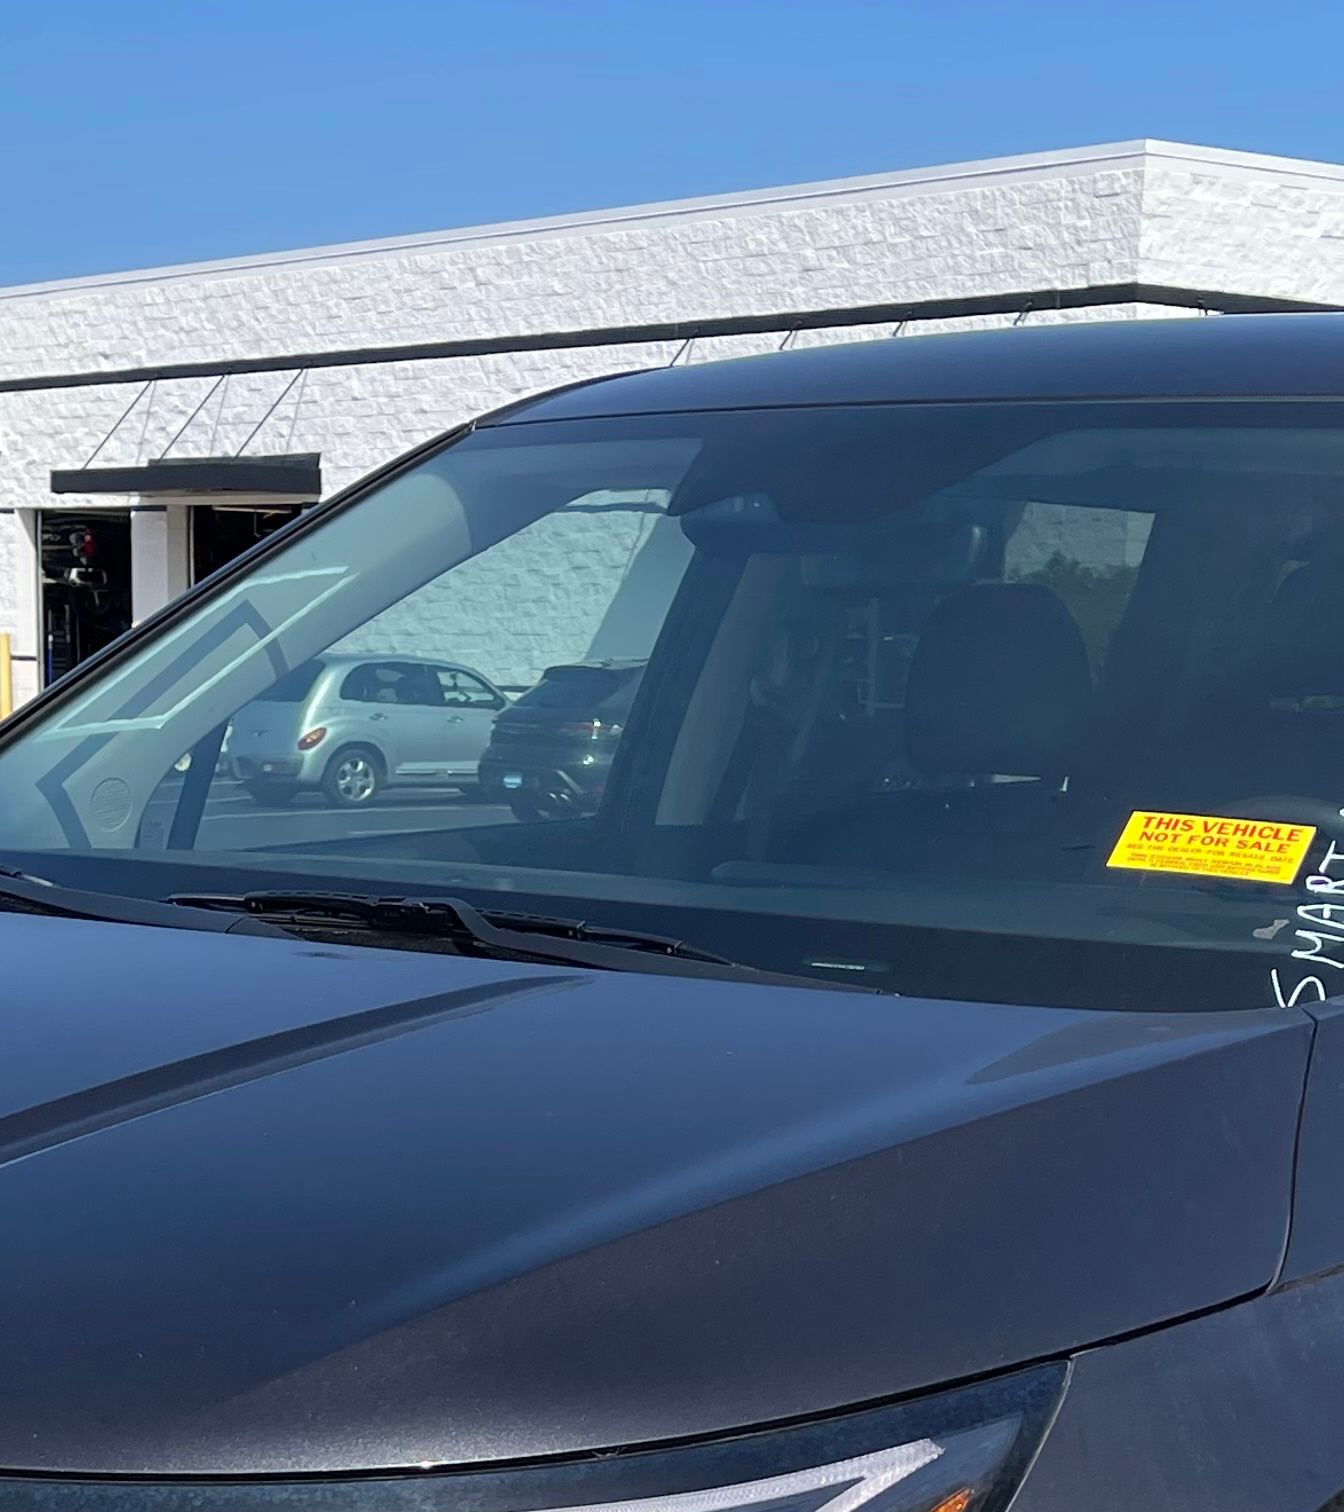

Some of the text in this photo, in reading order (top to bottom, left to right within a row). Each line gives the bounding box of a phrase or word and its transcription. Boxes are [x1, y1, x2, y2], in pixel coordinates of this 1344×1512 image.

[1143, 816, 1302, 842] THIS VEHICLE
[1139, 831, 1292, 854] NOT FOR SALE
